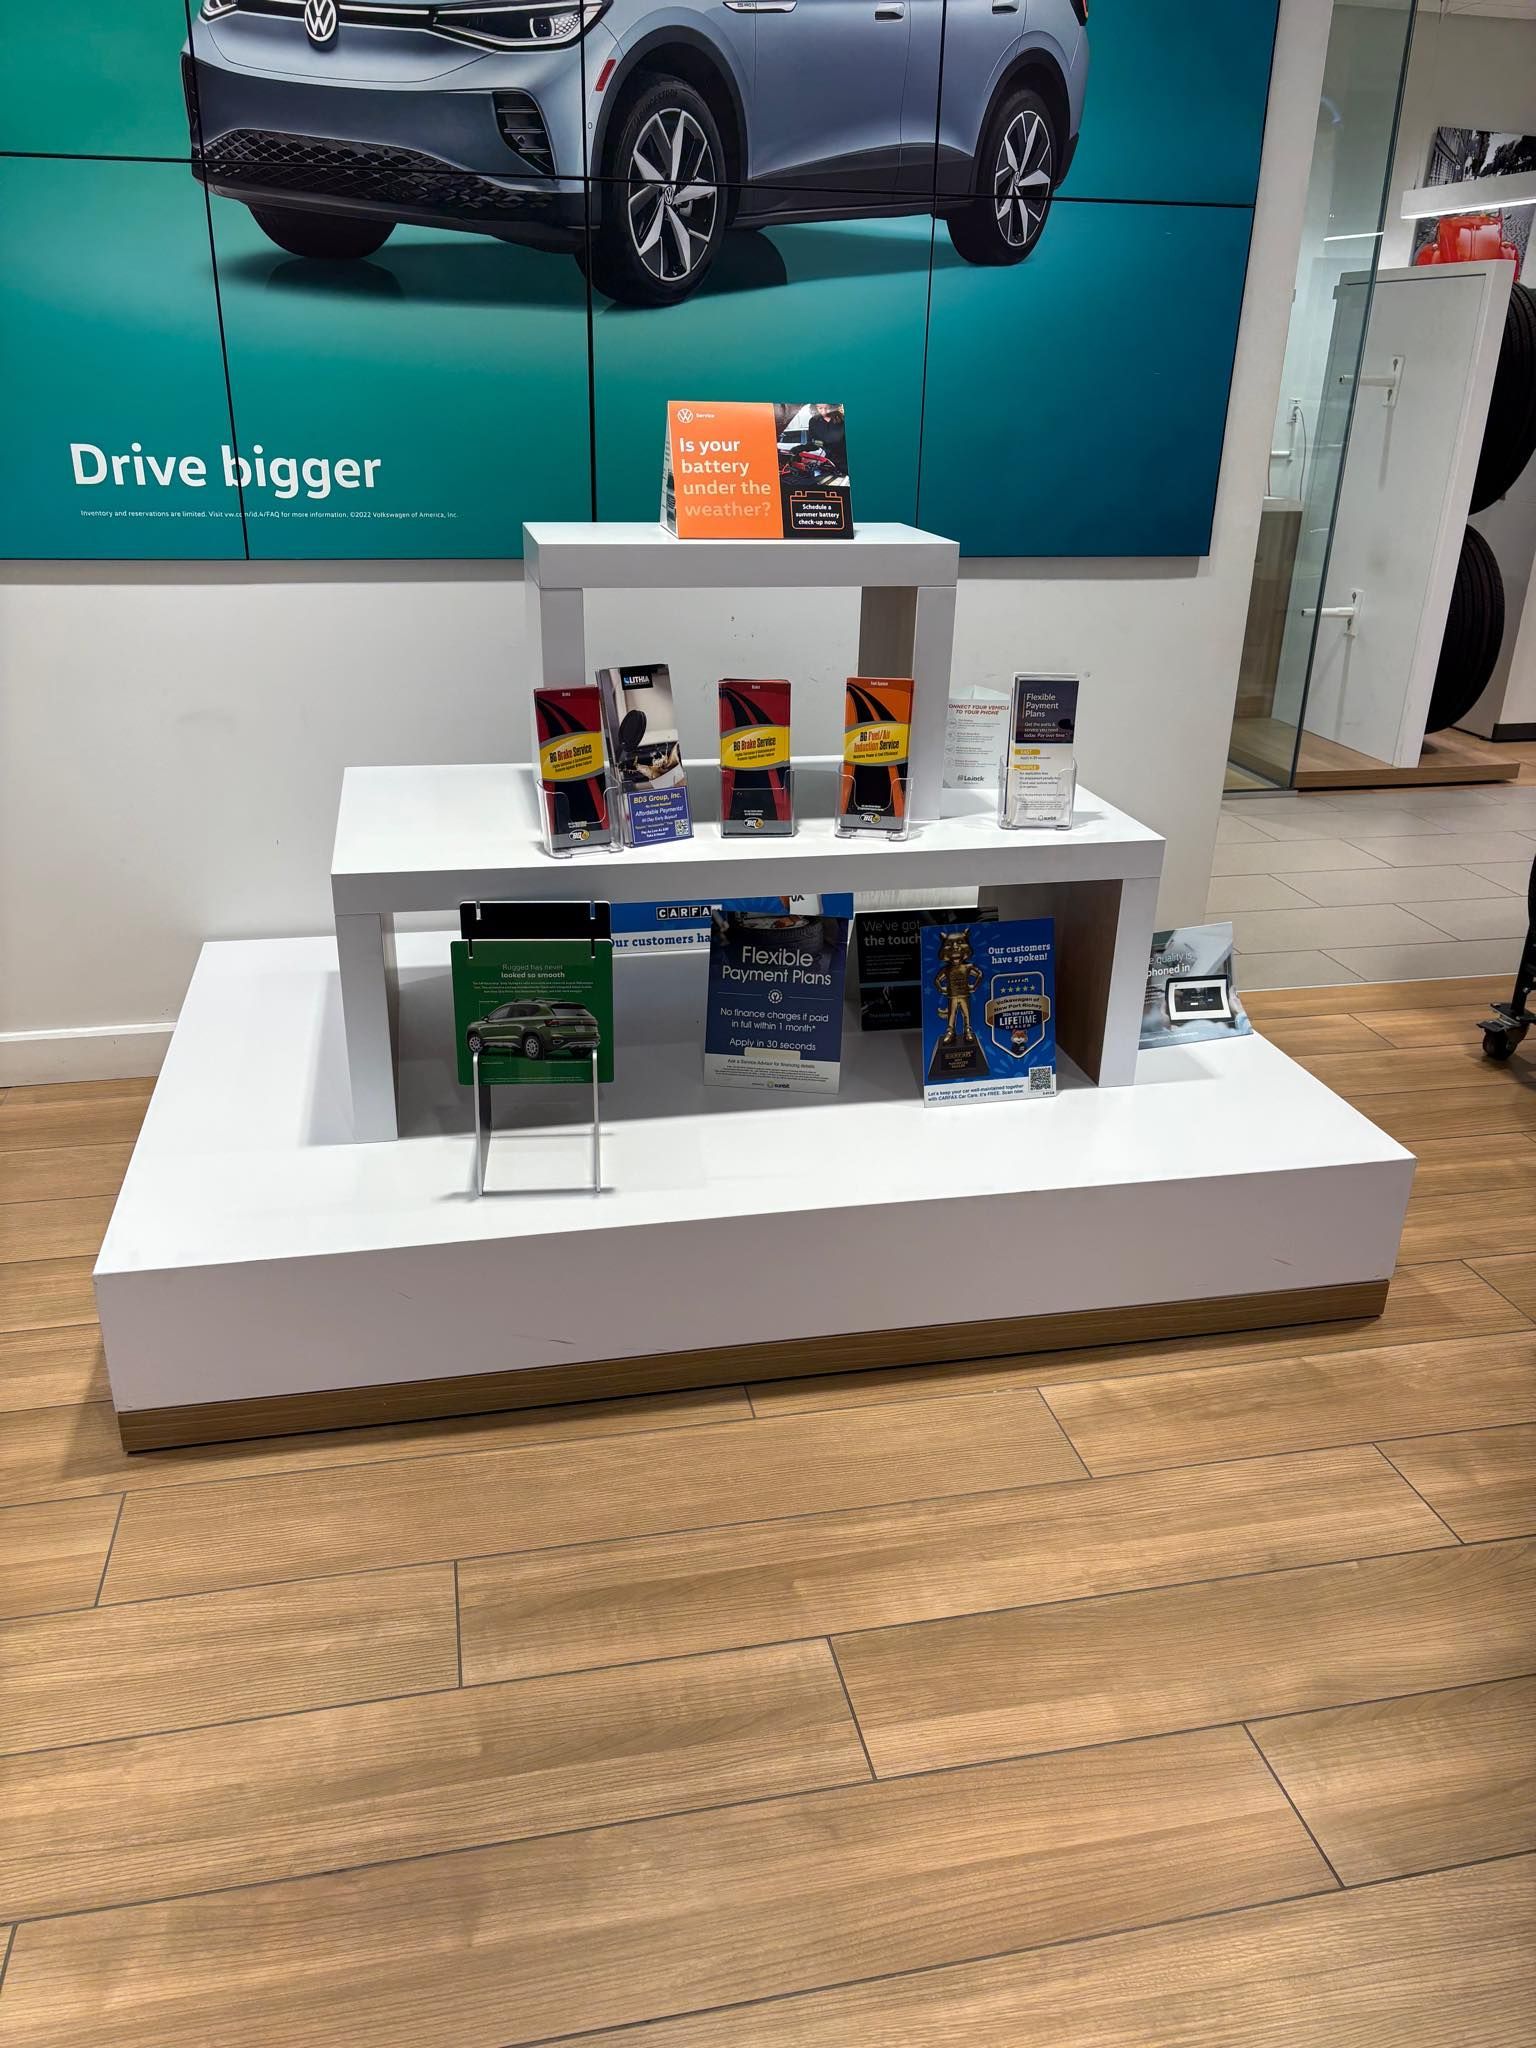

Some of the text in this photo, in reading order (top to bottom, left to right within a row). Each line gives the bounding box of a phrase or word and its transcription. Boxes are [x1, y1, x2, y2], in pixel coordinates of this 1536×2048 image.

[680, 438, 741, 456] Is your
[69, 443, 382, 499] Drive bigger
[681, 459, 750, 477] battery
[683, 480, 772, 496] under the
[80, 510, 113, 518] Inventory
[372, 512, 410, 520] Volkswagen
[684, 502, 770, 517] weather?
[820, 511, 840, 520] battery
[798, 518, 824, 527] check-up
[629, 676, 650, 684] LITHIA
[1026, 693, 1056, 701] Flexible
[1026, 702, 1059, 710] Payment
[1025, 710, 1046, 718] Plans
[860, 730, 891, 742] BG Fuel/Air
[733, 737, 776, 752] BG Brake Service
[854, 740, 900, 752] Induction Service
[549, 744, 592, 763] BG Brake Service
[633, 796, 648, 804] BDS
[648, 794, 670, 802] Group,
[657, 905, 713, 919] CARFA
[863, 920, 920, 932] We've got
[632, 935, 694, 947] customers
[697, 933, 712, 944] ha
[864, 932, 922, 946] the touch
[988, 944, 1051, 954] Our customers
[742, 946, 814, 967] Flexible
[992, 952, 1048, 964] have spoken!
[1156, 953, 1183, 966] quality
[1186, 952, 1192, 960] is
[502, 964, 528, 972] Rugged
[1182, 964, 1190, 972] in
[722, 966, 832, 986] Payment Plans
[720, 1008, 829, 1024] No finance charges if paid
[1000, 1014, 1037, 1026] LIFETIME
[740, 1020, 752, 1028] full
[754, 1022, 776, 1030] within
[779, 1022, 782, 1030] 1
[730, 1038, 816, 1051] Apply in 30 seconds
